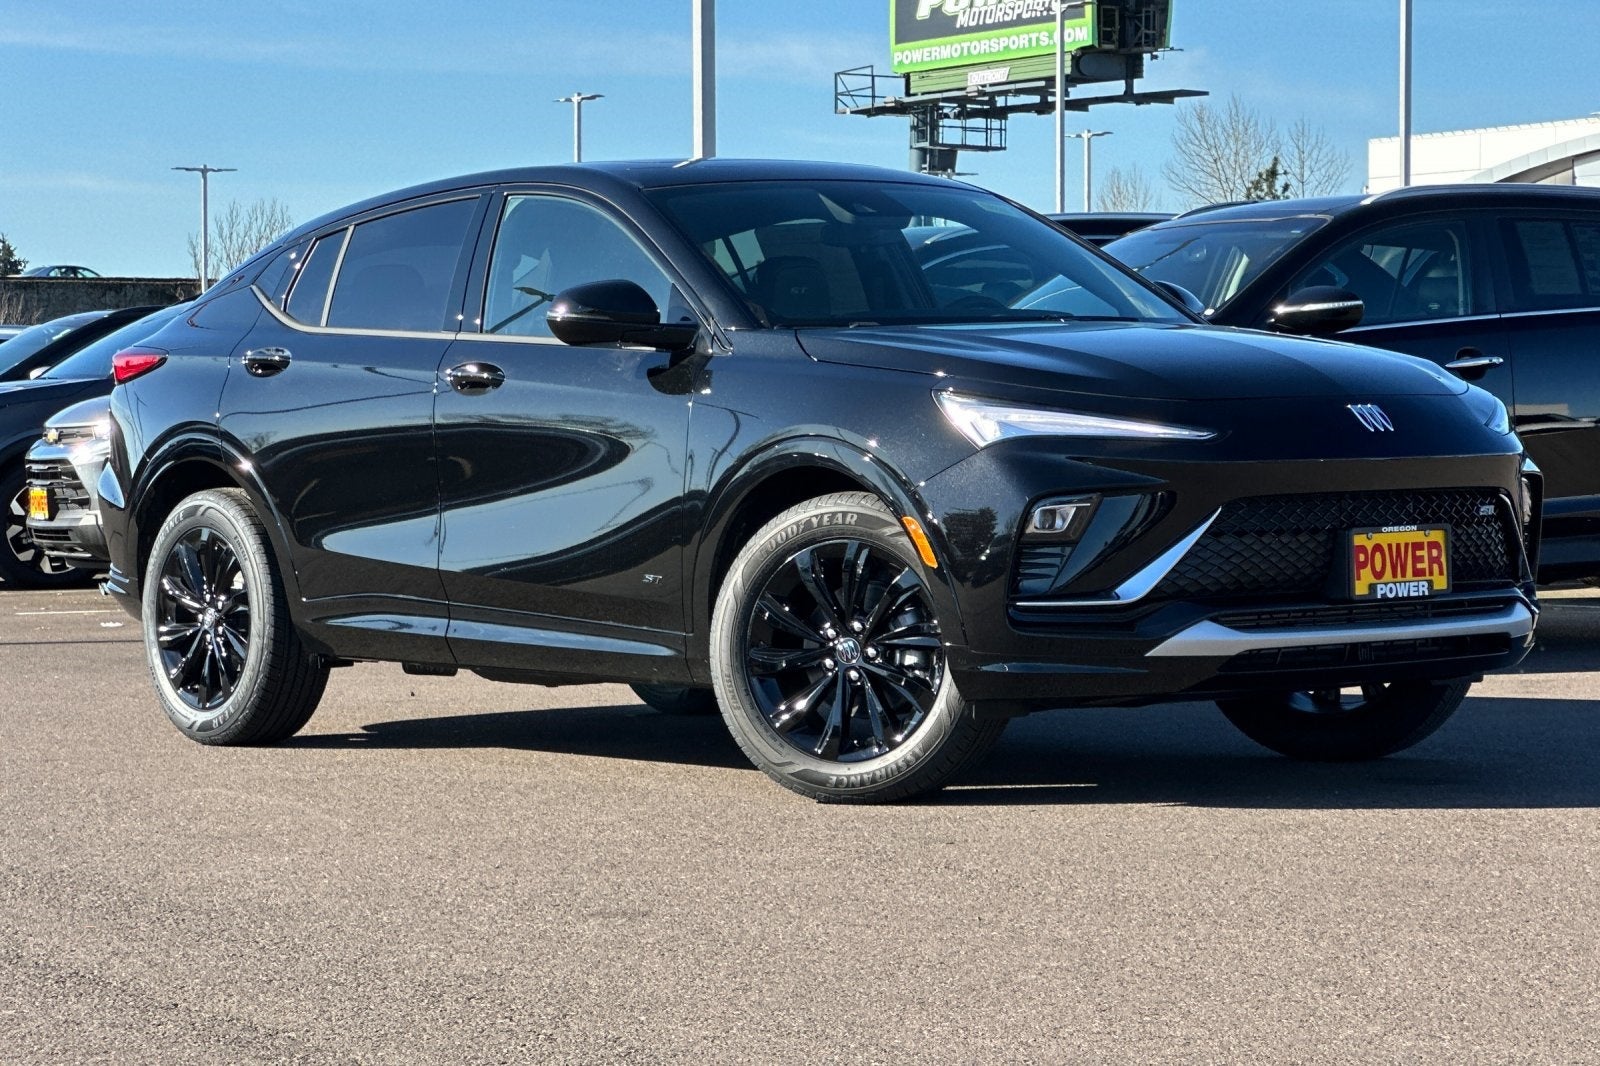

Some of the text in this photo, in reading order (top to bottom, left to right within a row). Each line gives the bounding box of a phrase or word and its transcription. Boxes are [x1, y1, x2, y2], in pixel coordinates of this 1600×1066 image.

[1381, 525, 1418, 533] OREGON
[1354, 541, 1444, 581] POWER
[642, 574, 663, 585] ST
[1377, 581, 1429, 599] POWER
